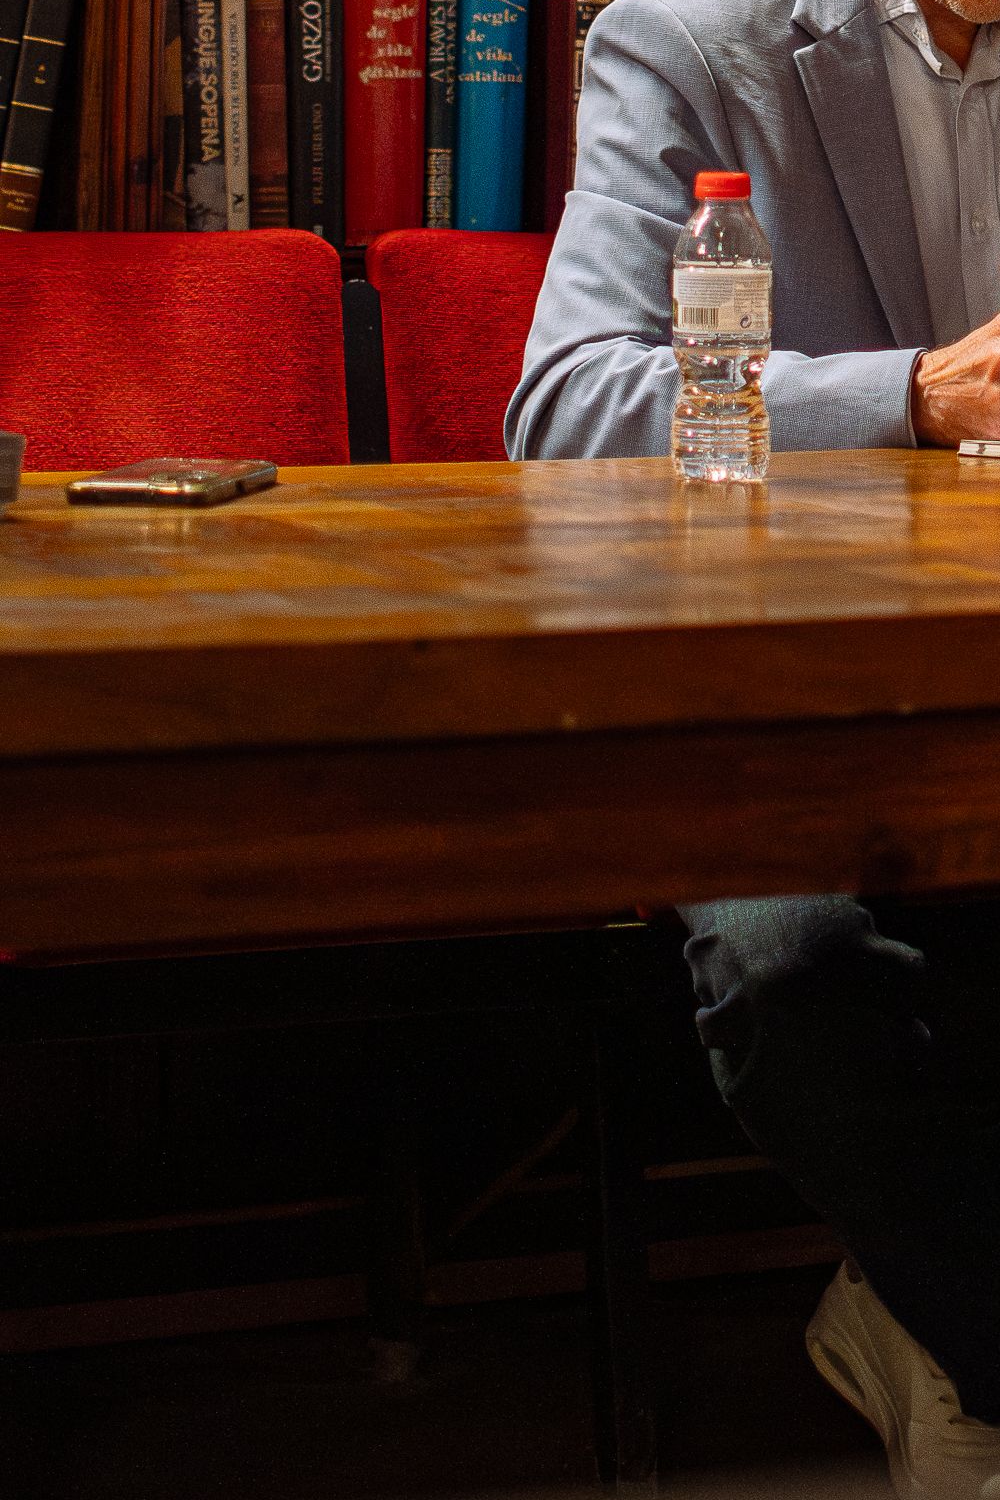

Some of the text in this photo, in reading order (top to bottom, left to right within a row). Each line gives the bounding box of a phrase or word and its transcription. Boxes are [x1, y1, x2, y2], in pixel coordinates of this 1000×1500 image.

[373, 5, 416, 23] segle
[472, 9, 518, 27] segle
[366, 25, 387, 40] de
[465, 29, 486, 43] de
[376, 44, 413, 57] vida
[476, 47, 513, 62] vida
[358, 66, 422, 85] atalana
[457, 70, 524, 83] catalana
[230, 95, 240, 109] DE
[200, 72, 221, 162] SOPENA
[311, 102, 324, 205] PILAR URBANO
